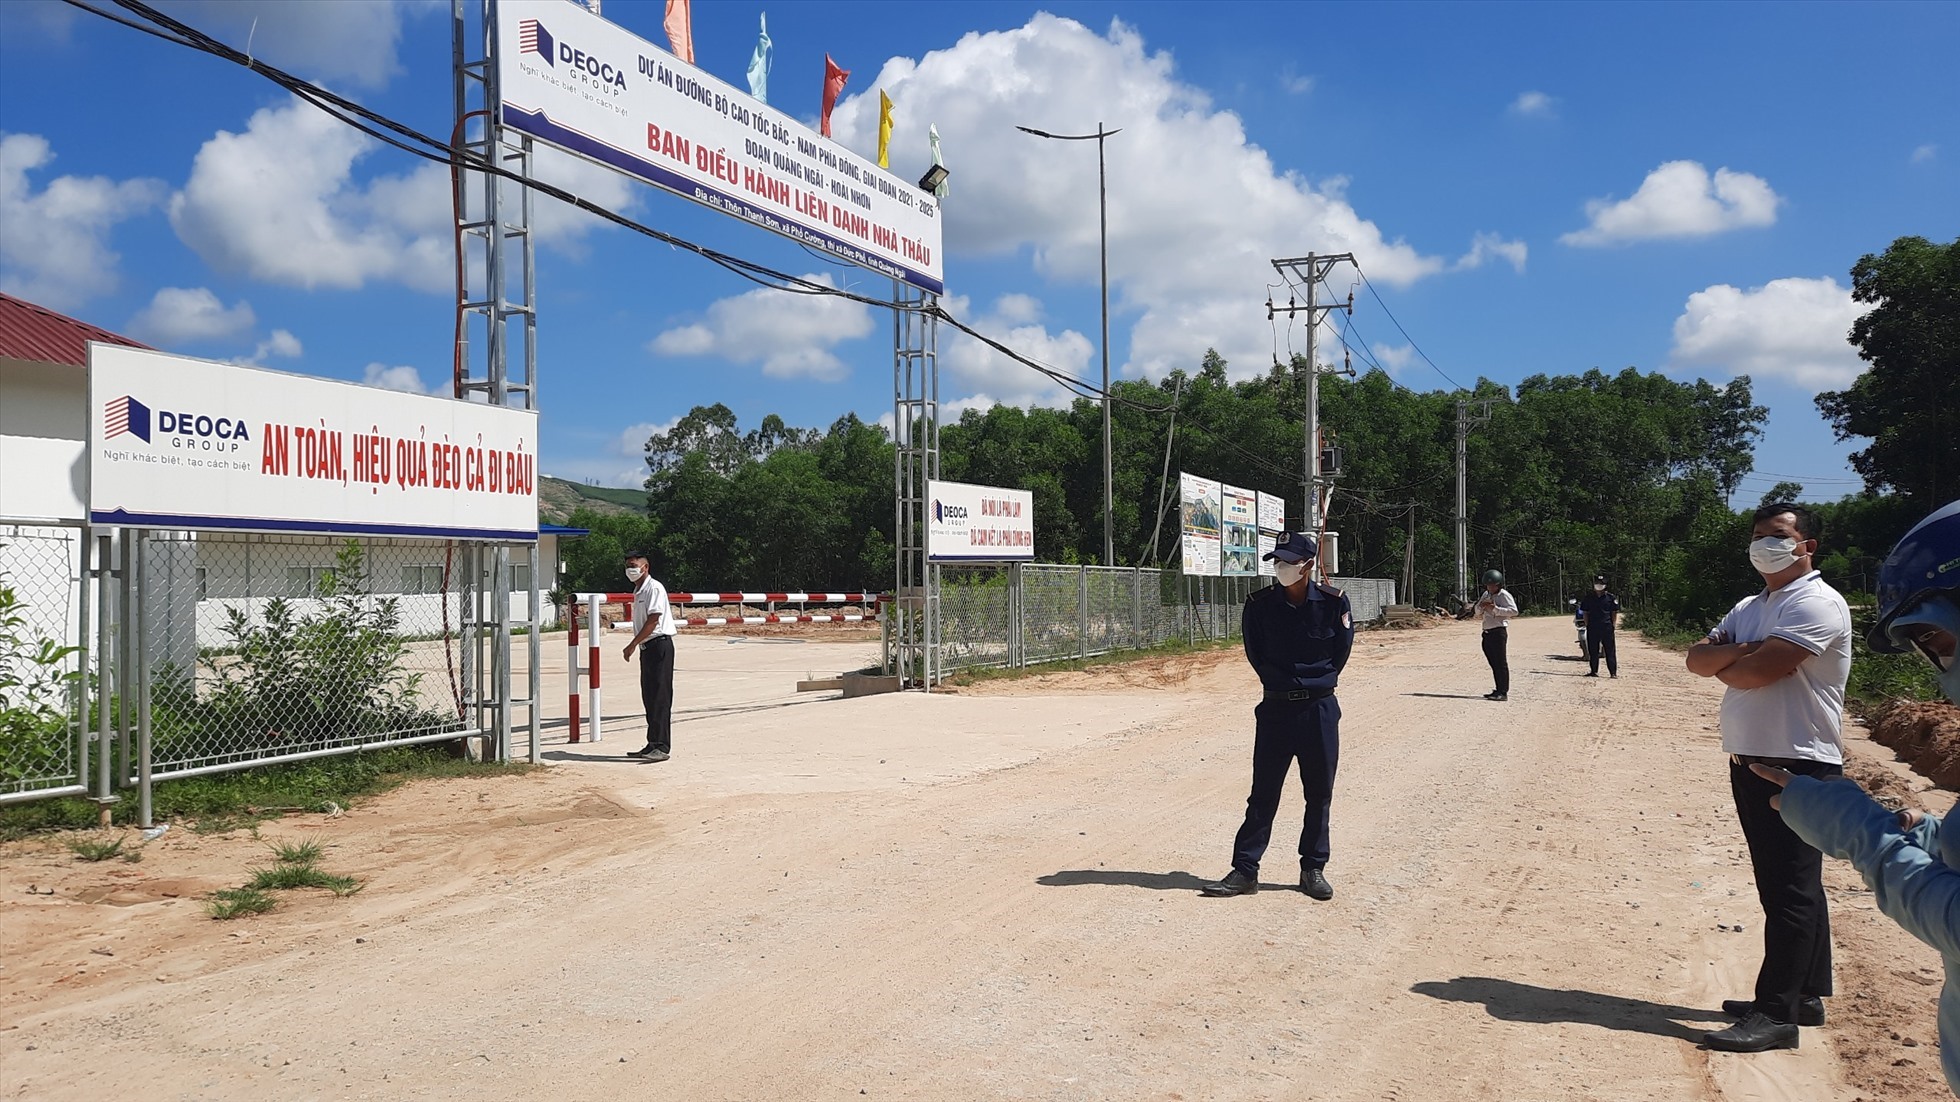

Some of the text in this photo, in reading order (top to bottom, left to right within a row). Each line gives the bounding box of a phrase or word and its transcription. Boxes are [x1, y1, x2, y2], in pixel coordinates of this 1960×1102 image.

[559, 41, 627, 91] DEOCA
[569, 69, 619, 97] GROUP
[519, 62, 539, 77] Nghĩ
[541, 71, 560, 87] khác
[596, 97, 613, 110] cách
[638, 54, 655, 82] DỰ
[657, 62, 673, 89] ÁN
[676, 74, 712, 108] ĐƯỜNG
[715, 93, 729, 119] BỘ
[731, 102, 749, 126] CAO
[752, 111, 770, 136] TỐC
[772, 120, 789, 146] BẮC
[797, 136, 817, 160] NAM
[819, 145, 837, 170] PHÍA
[839, 157, 861, 184] ĐÔNG,
[863, 170, 877, 192] GIAI
[878, 180, 897, 202] ĐOẠN
[898, 188, 913, 208] 2021
[919, 199, 934, 218] 2025
[745, 137, 771, 165] ĐOẠN
[773, 151, 802, 179] QUẢNG
[804, 167, 824, 189] NGÃI
[831, 178, 849, 201] HOÀI
[850, 188, 871, 211] NHƠN
[647, 122, 930, 267] BAN ĐIỀU HÀNH LIÊN DANH NHÀ THẦU
[724, 198, 742, 214] Thôn
[743, 206, 765, 223] Thanh
[159, 410, 250, 441] DEOCA
[172, 437, 239, 453] GROUP
[103, 450, 251, 471] Nghĩ khác biệt, tạo cách biệt
[261, 418, 533, 496] AN TOÀN, HIỆU QUẢ ĐÈO CẢ ĐI ĐẦU
[944, 505, 968, 518] DEOCA
